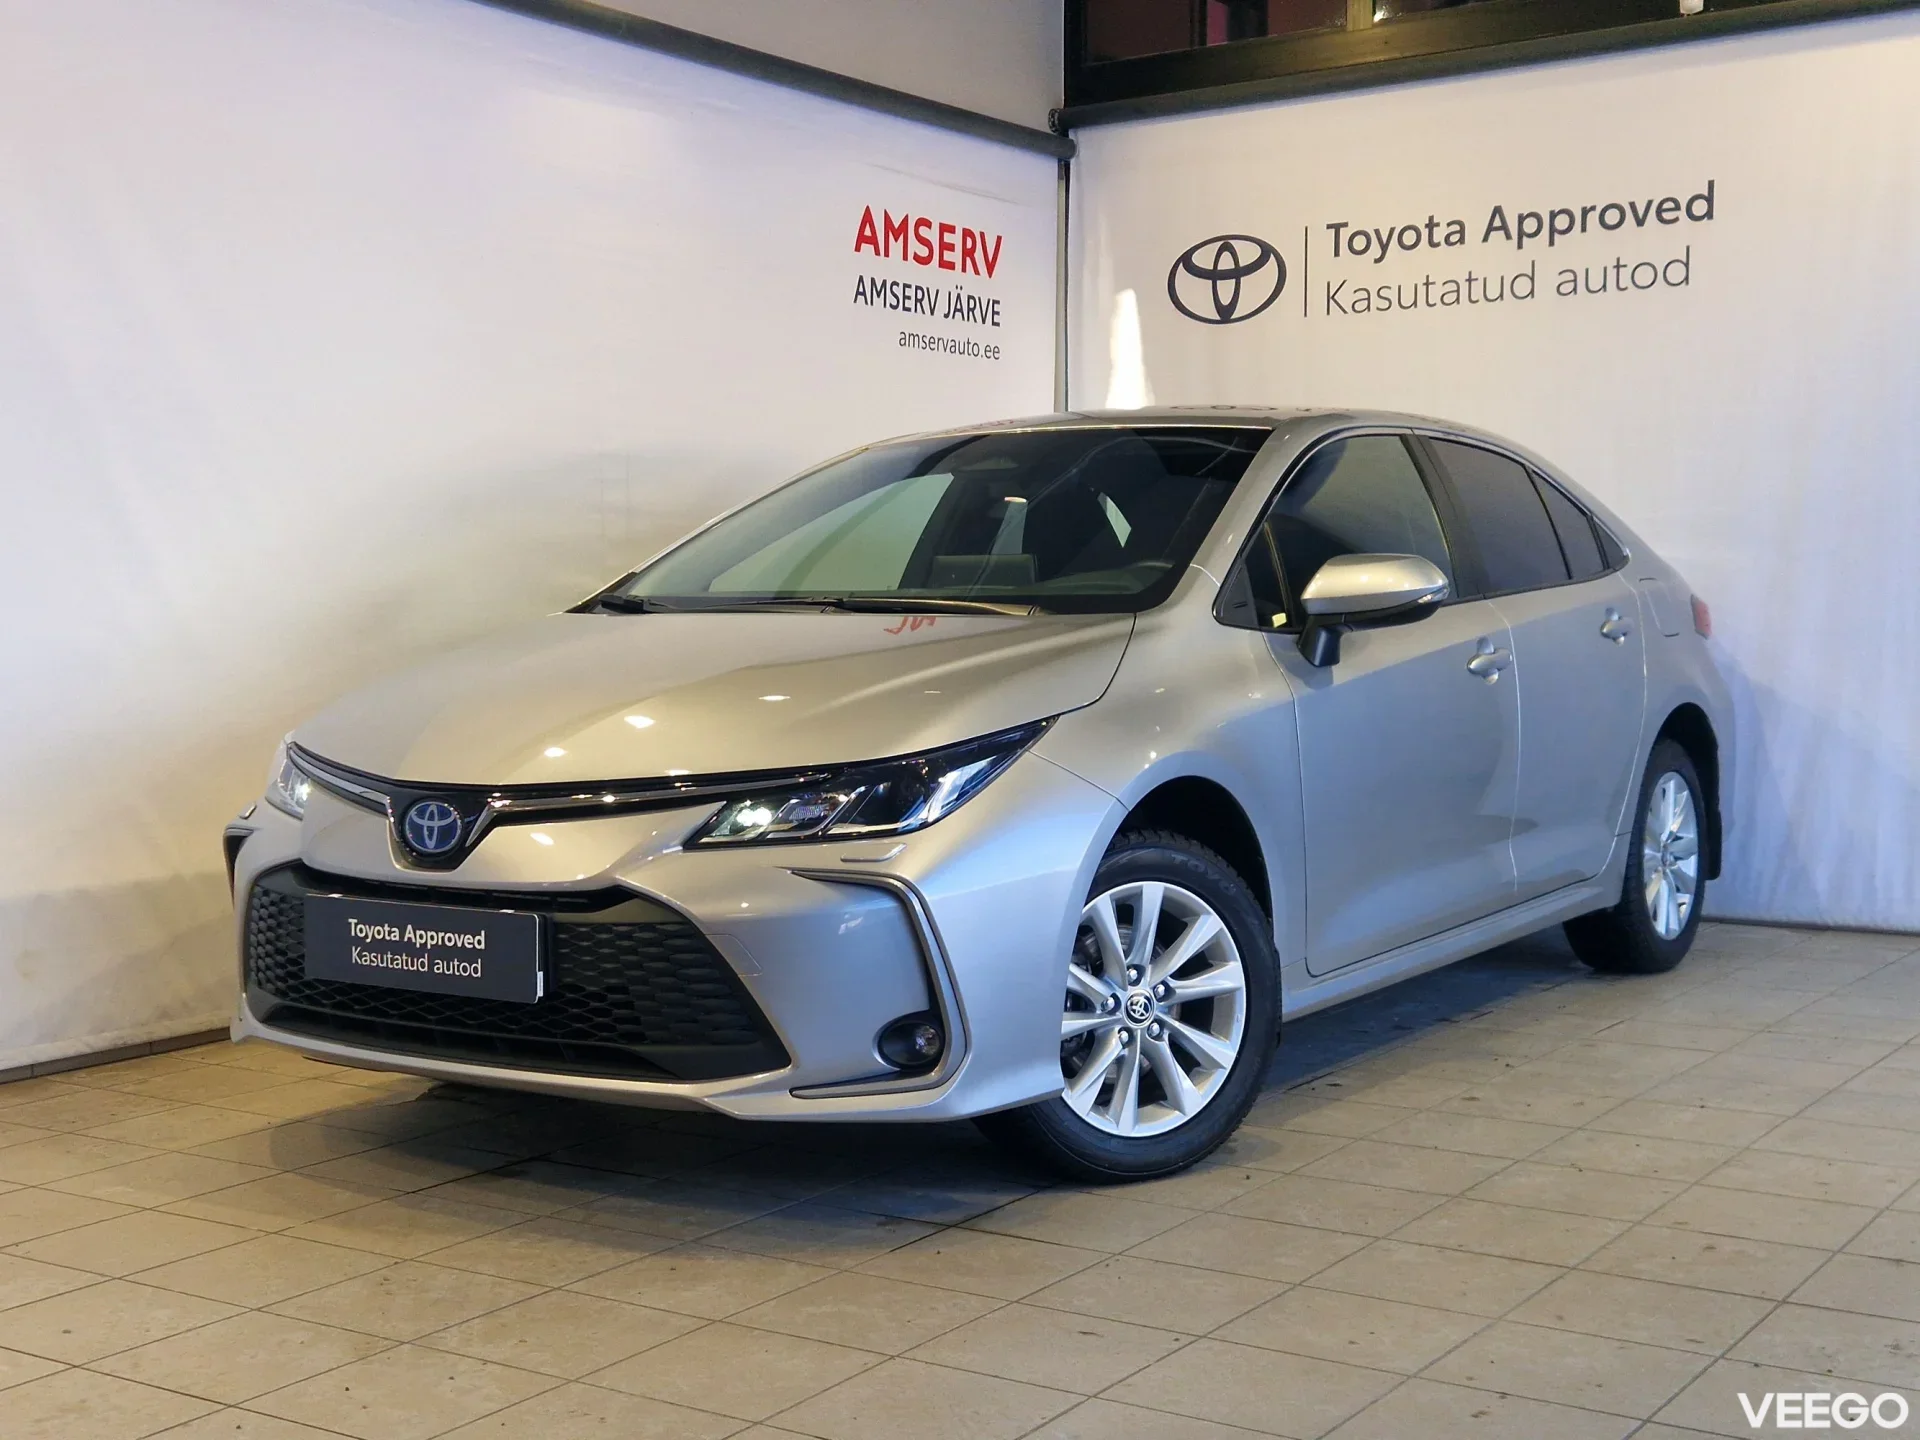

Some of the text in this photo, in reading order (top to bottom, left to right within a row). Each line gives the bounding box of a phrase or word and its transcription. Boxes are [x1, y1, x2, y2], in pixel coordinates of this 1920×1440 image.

[854, 204, 1003, 279] AMSERV
[1326, 179, 1715, 264] Toyota Approved
[853, 275, 1001, 327] AMSERV JÄRVE
[1326, 245, 1691, 316] Kasutatud autod
[898, 331, 1001, 360] amservauto.ee
[348, 918, 486, 949] Toyota Approved
[351, 946, 482, 978] Kasutatud autod
